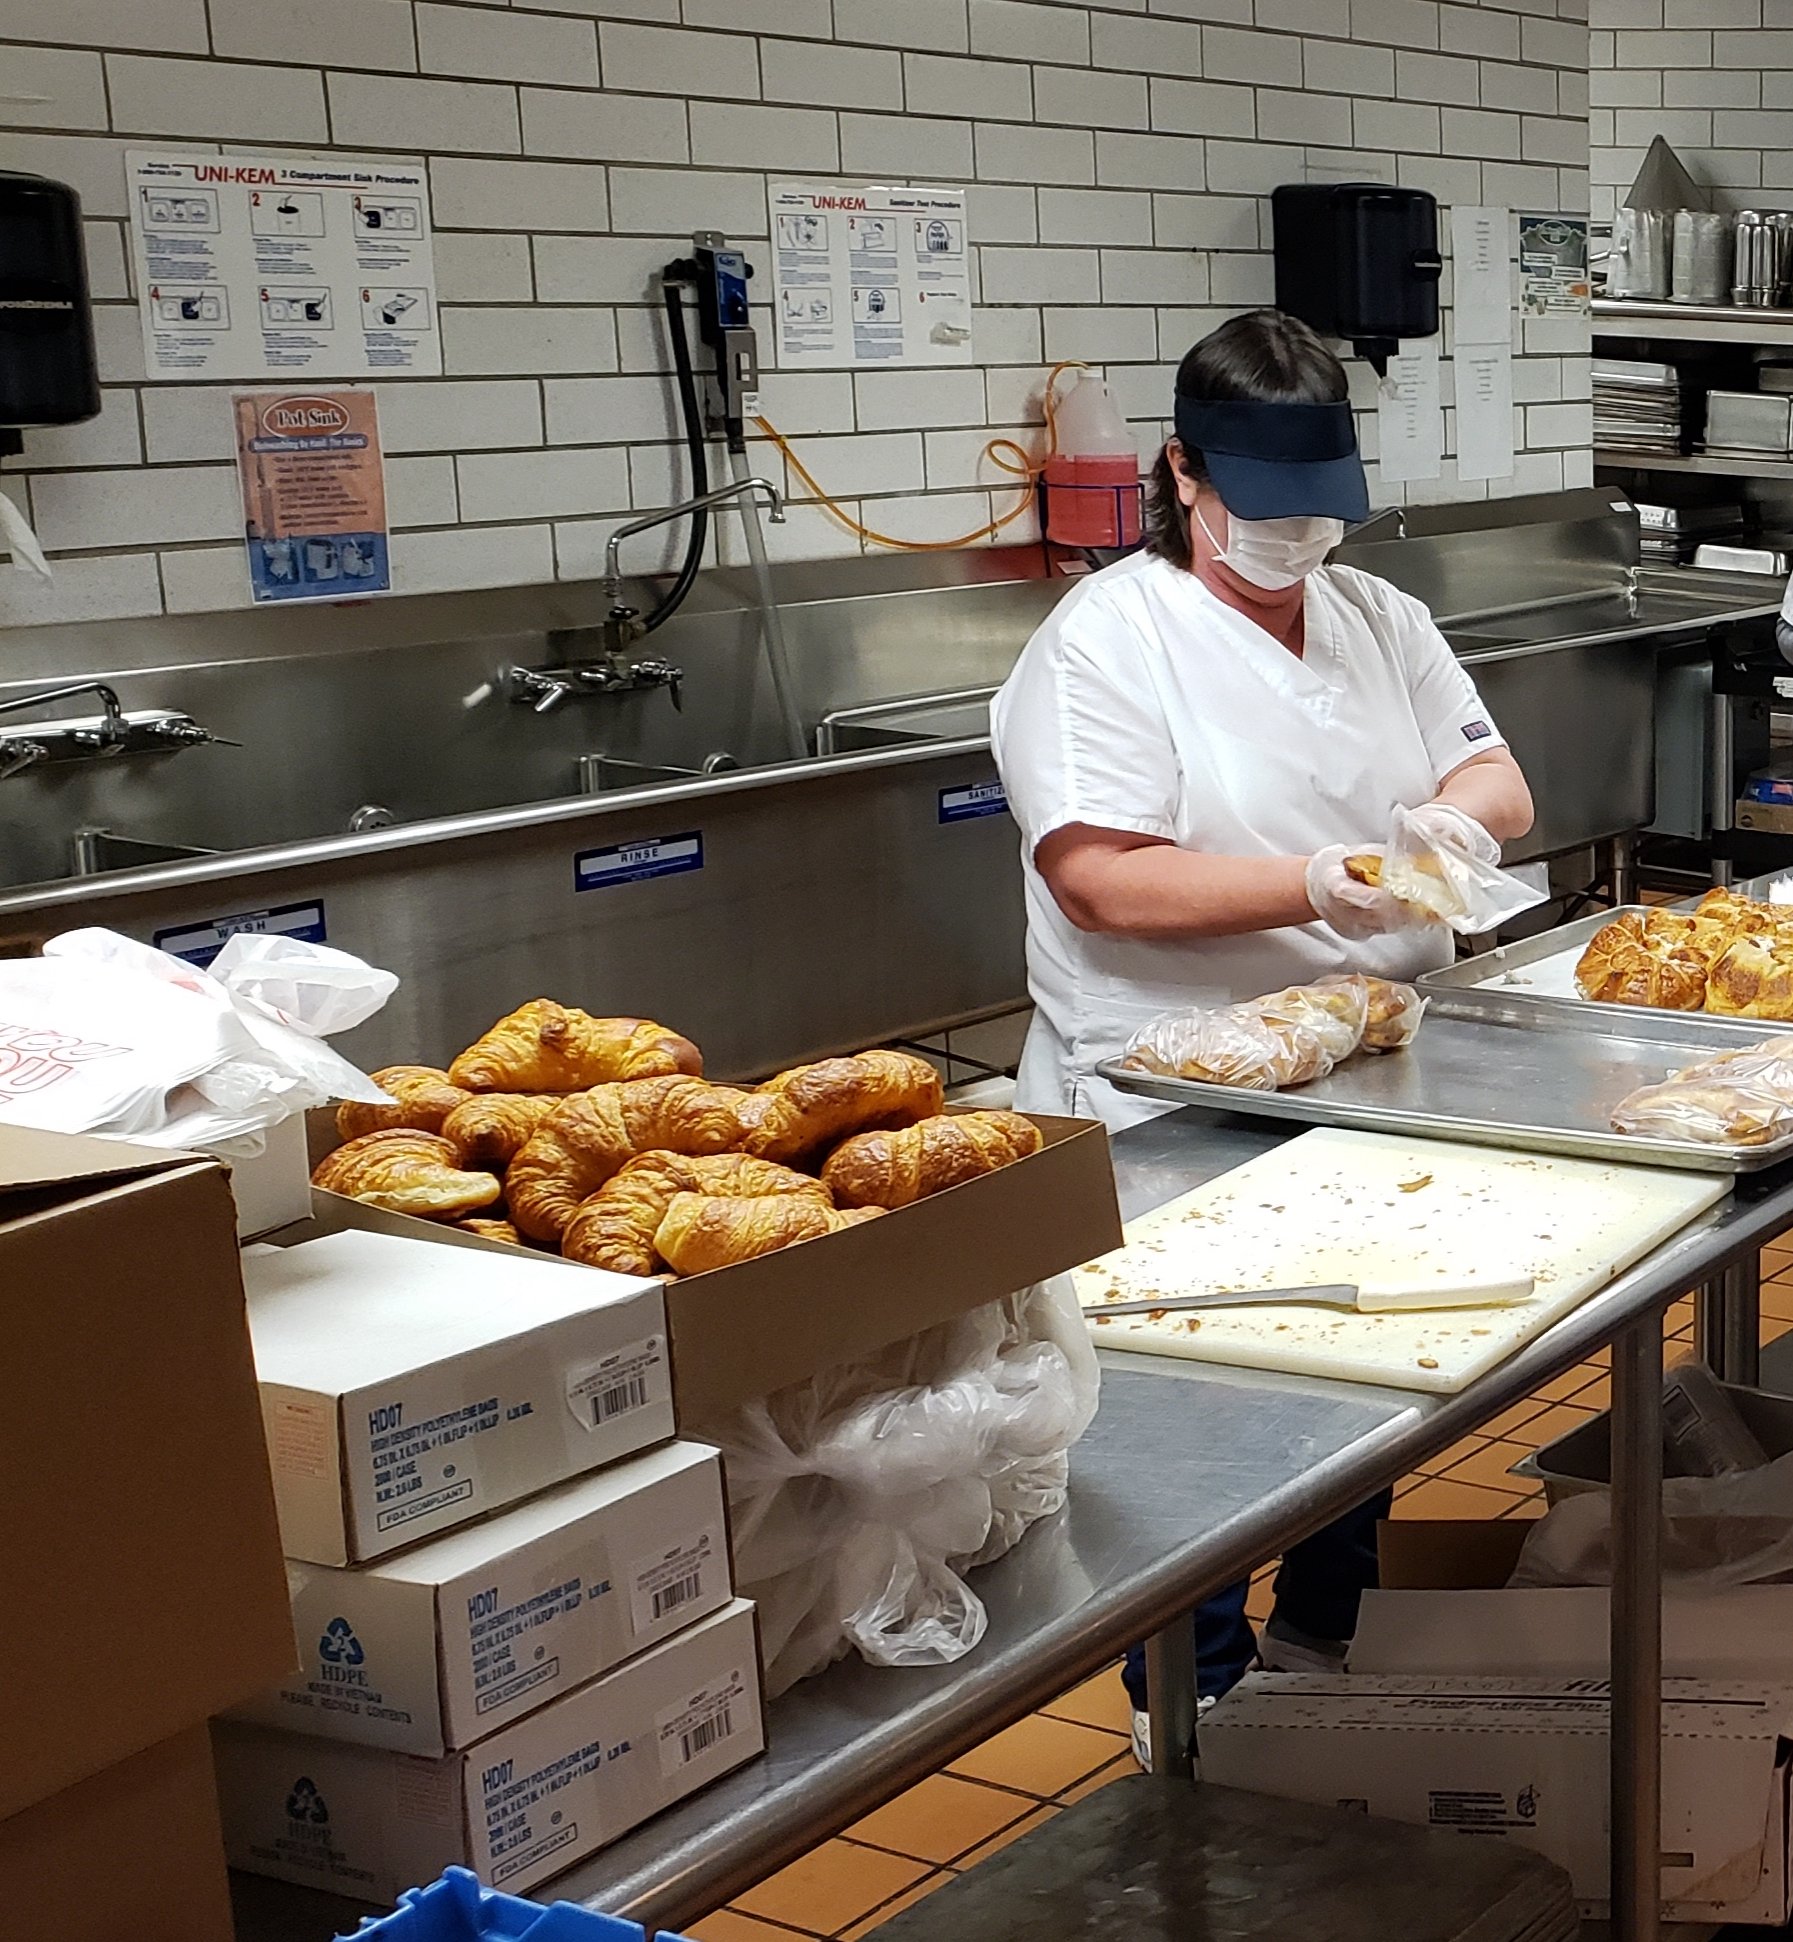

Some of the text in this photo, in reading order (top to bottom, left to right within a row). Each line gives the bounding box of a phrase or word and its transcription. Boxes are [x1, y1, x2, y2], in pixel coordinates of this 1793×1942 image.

[194, 165, 276, 185] UNI-KEM
[289, 170, 351, 181] Compartment
[354, 173, 372, 182] Sink
[375, 175, 419, 185] Procedure
[141, 188, 148, 203] 1
[252, 193, 260, 207] 2
[812, 196, 867, 210] UNI-KEM
[779, 217, 784, 228] 1
[850, 219, 855, 230] 2
[151, 287, 160, 302] 4
[261, 288, 269, 302] 5
[362, 289, 370, 302] 6
[783, 291, 789, 301] 4
[854, 291, 859, 301] 5
[919, 292, 925, 303] 6
[276, 408, 342, 427] Pot Sink
[968, 787, 1005, 800] SANITIZ
[620, 848, 659, 863] RINSE
[216, 920, 267, 939] WASH
[369, 1403, 402, 1435] HD07
[391, 1427, 422, 1446] DENSITY
[422, 1405, 477, 1437] POLYETHYLENE
[396, 1461, 417, 1478] CASE
[387, 1486, 464, 1524] FDA COMPLIANT
[468, 1587, 498, 1622] HD07
[337, 1637, 345, 1651] 2
[493, 1645, 511, 1663] CASE
[321, 1664, 368, 1687] HDPE
[483, 1665, 553, 1708] FDA COMPLIANT
[321, 1697, 360, 1714] RECYCLE
[366, 1704, 411, 1724] CONTENTS
[482, 1758, 513, 1793] HD07
[503, 1779, 530, 1801] DENSITY
[508, 1812, 526, 1831] CASE
[501, 1831, 570, 1877] FDA COMPLIANT
